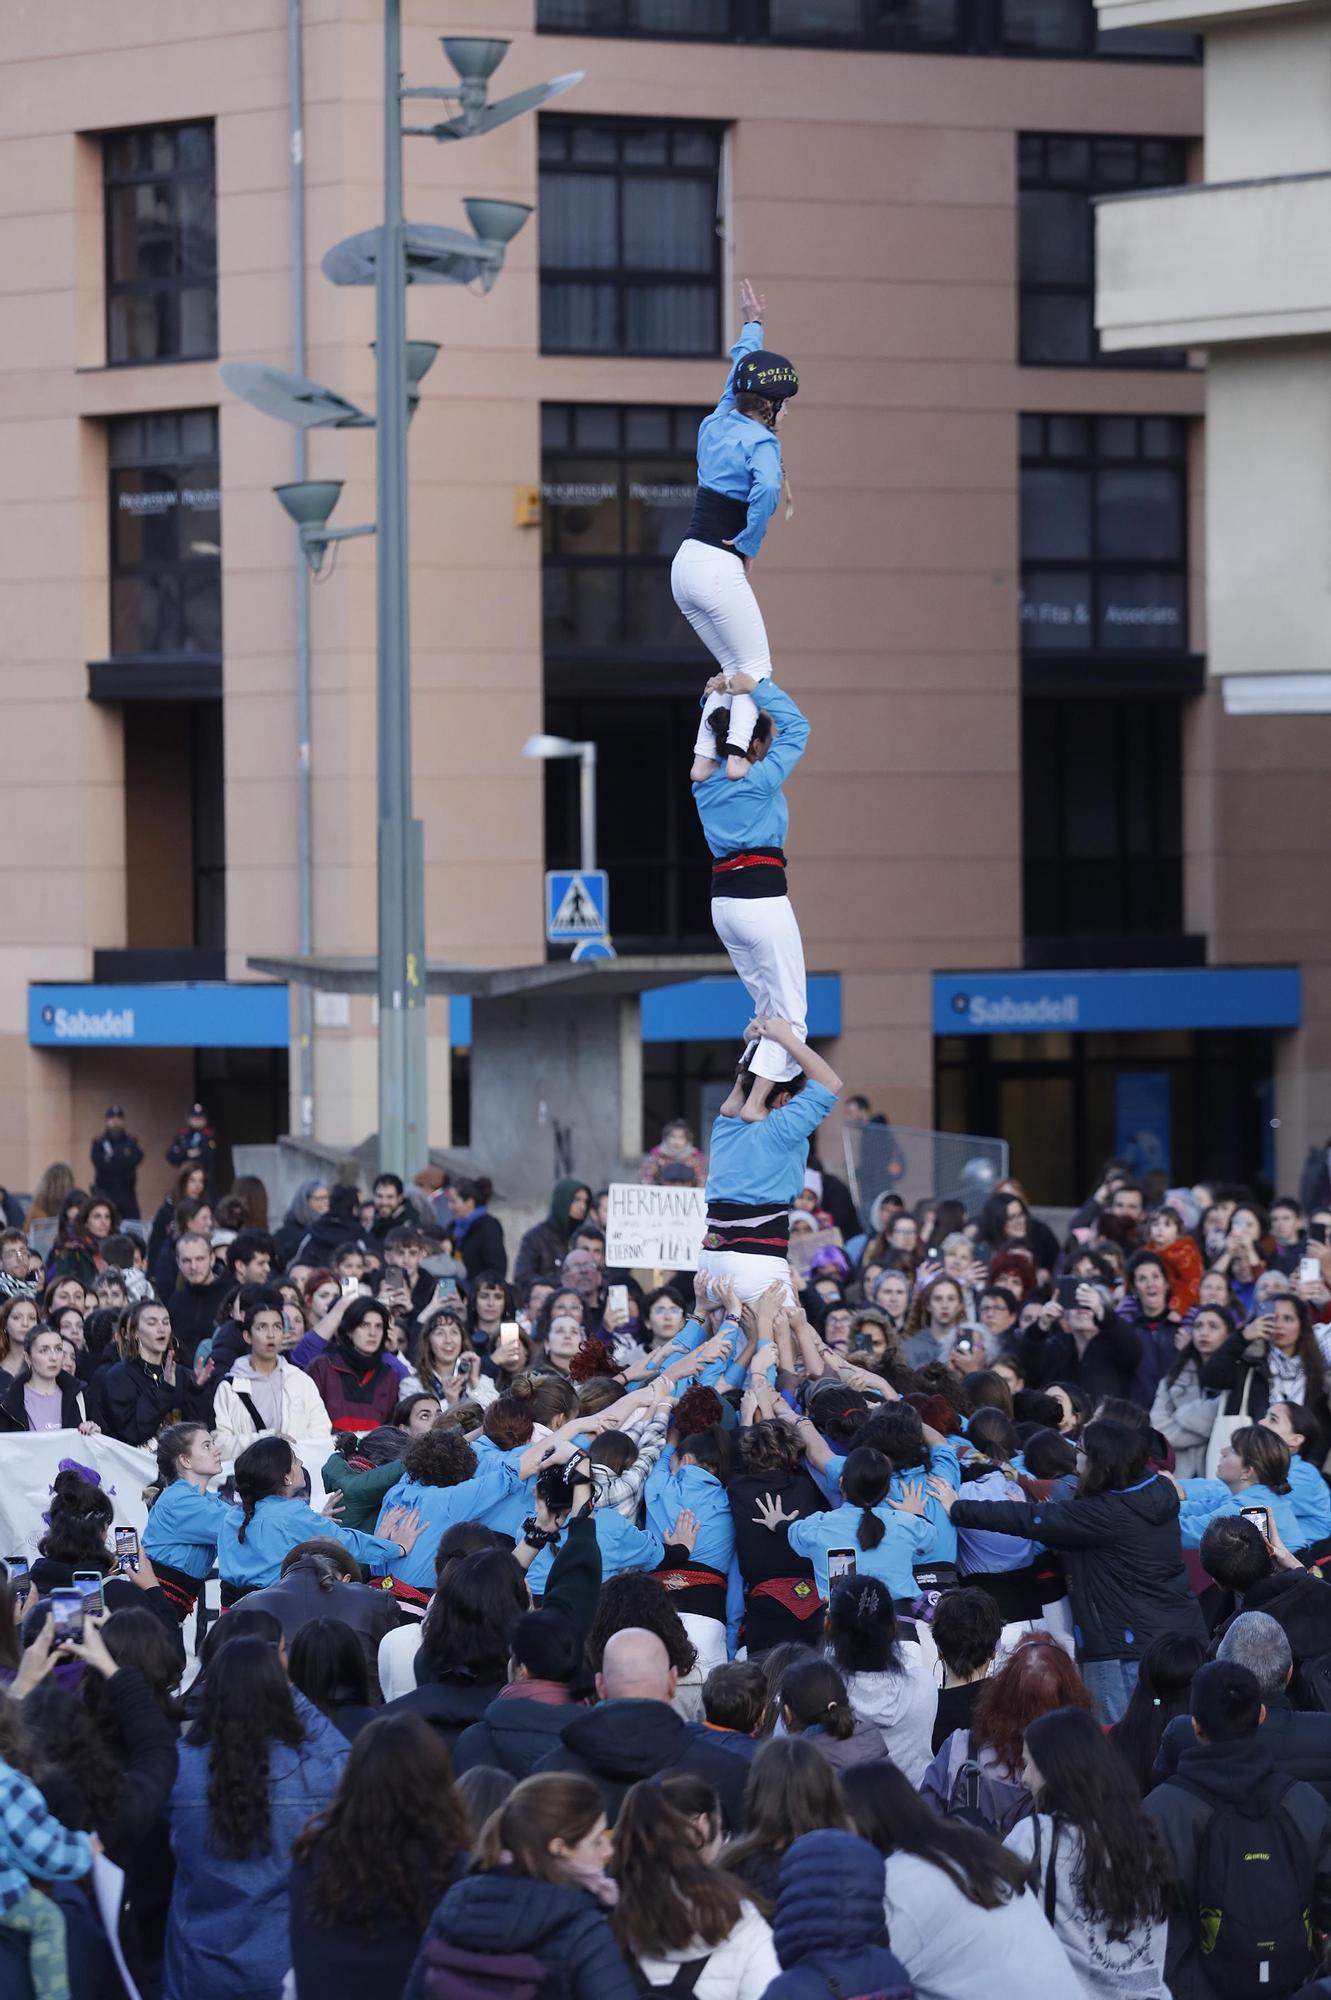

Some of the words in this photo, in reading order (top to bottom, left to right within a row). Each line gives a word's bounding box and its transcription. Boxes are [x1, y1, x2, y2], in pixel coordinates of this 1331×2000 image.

[55, 1008, 135, 1038] Sabadell
[970, 994, 1079, 1026] Sabadell
[612, 1188, 702, 1217] HERMANA
